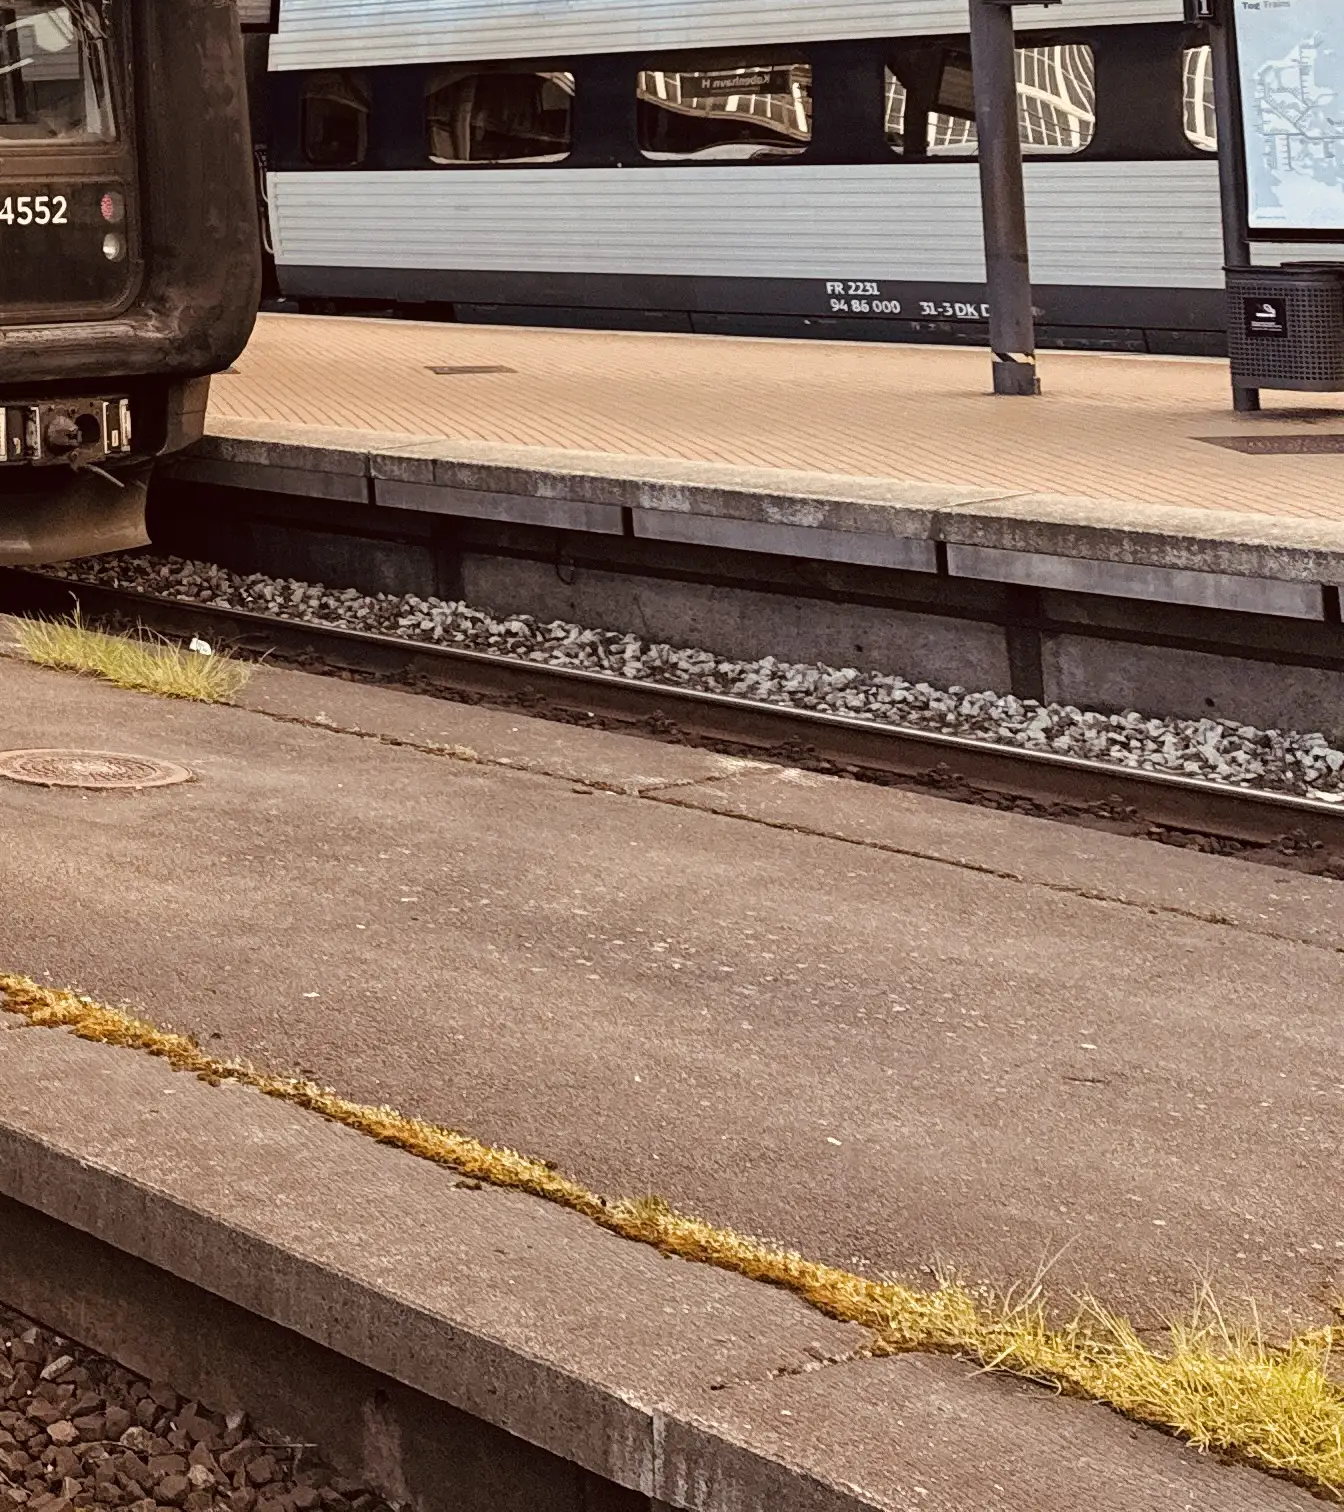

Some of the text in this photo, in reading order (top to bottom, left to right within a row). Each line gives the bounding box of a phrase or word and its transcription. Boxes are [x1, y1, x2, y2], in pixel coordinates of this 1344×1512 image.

[825, 281, 880, 295] FR 2231
[829, 298, 849, 312] 94
[850, 299, 869, 313] 86
[872, 300, 901, 314] 000
[919, 301, 954, 316] 31-3
[954, 303, 980, 318] DK
